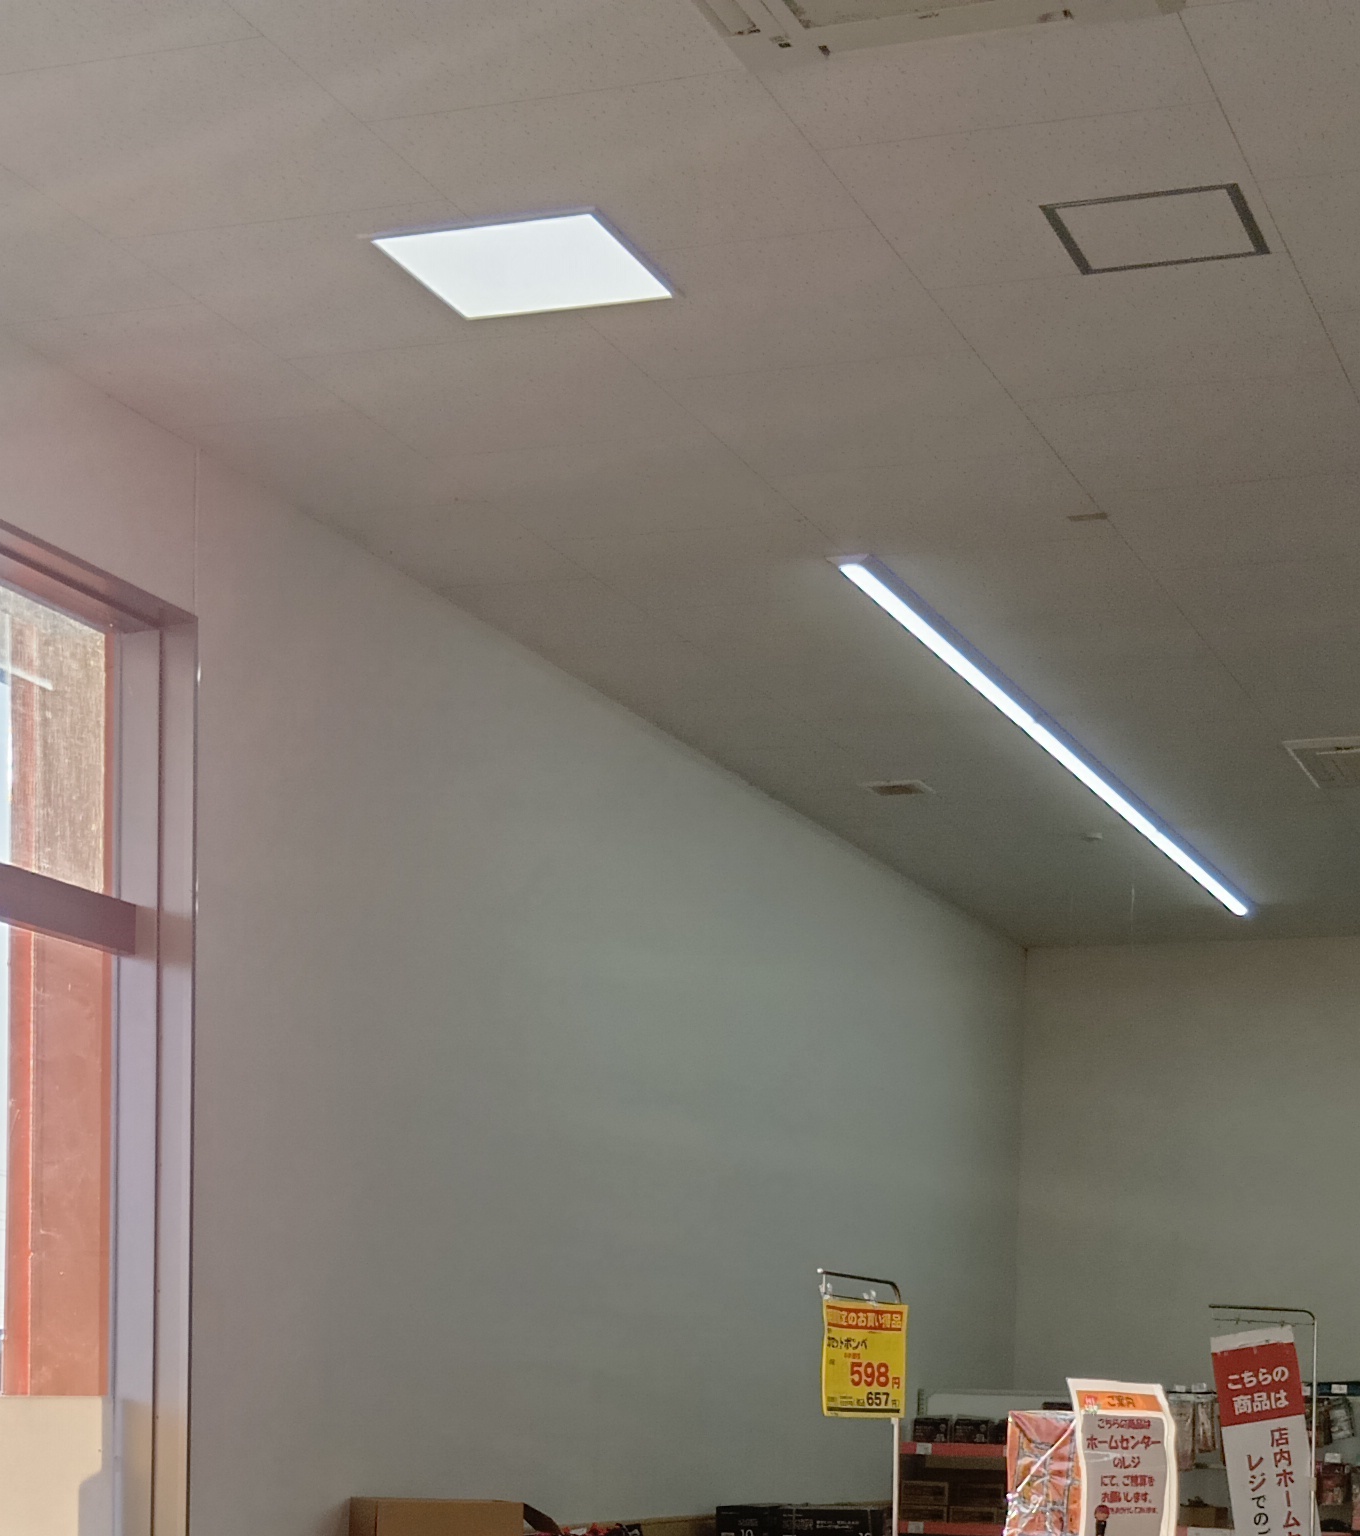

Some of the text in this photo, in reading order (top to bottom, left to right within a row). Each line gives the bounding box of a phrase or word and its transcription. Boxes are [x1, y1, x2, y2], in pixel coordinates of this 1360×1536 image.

[1227, 1366, 1289, 1390] こちらの
[1233, 1390, 1288, 1414] 商品は
[1098, 1419, 1151, 1429] こちらの商品は
[1087, 1435, 1161, 1450] ホームセンター
[1113, 1456, 1141, 1469] のレジ
